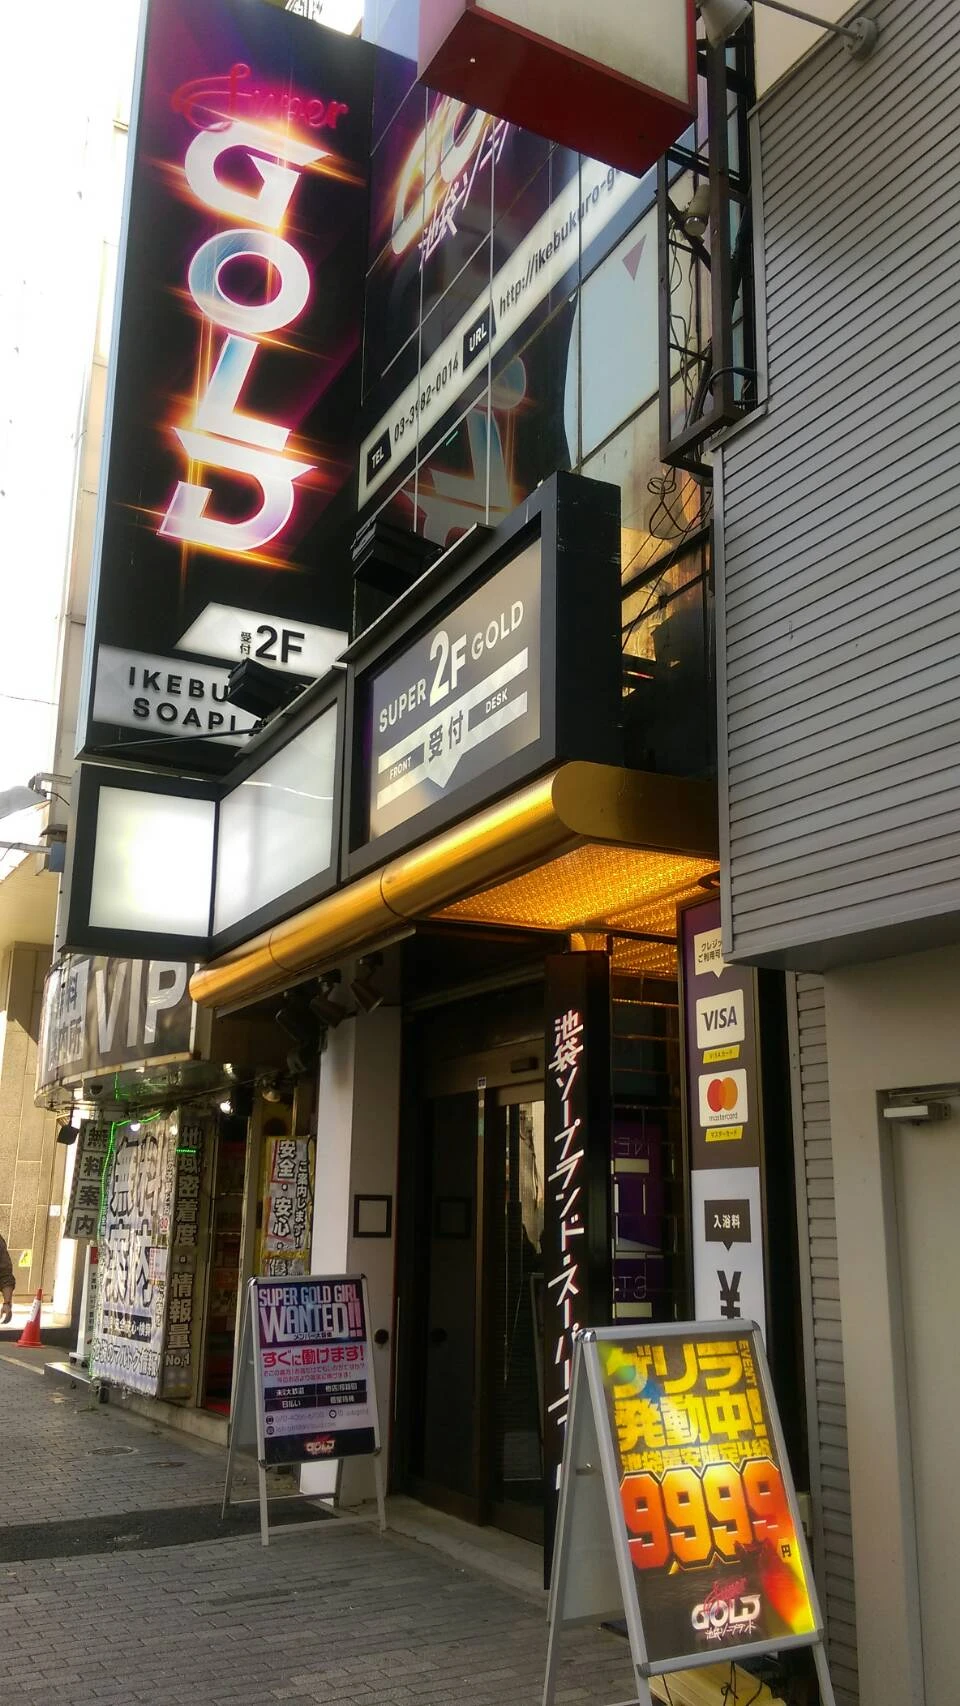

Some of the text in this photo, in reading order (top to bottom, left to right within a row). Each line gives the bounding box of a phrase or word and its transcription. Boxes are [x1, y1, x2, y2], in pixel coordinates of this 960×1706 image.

[157, 121, 332, 551] GOLD
[371, 445, 385, 469] TEL
[469, 323, 487, 351] URL
[499, 167, 618, 317] http://ikebukuro-g
[255, 625, 305, 663] 2F
[128, 666, 229, 703] IKEBU
[379, 600, 524, 733] SUPER 2F GOLD
[389, 688, 508, 780] FRONT 受付 DESK
[95, 958, 188, 1054] VIP
[701, 1006, 738, 1031] VISA
[708, 1112, 738, 1122] mastercard
[713, 1214, 741, 1229] 入浴料
[259, 1284, 360, 1307] SUPER GOLD GIRL
[260, 1302, 363, 1343] WANTED!!
[263, 1345, 365, 1368] すぐに働けます!
[607, 1340, 743, 1399] ゲリラ
[738, 1340, 757, 1386] EVENT
[614, 1388, 768, 1452] 発動中!
[619, 1457, 794, 1569] 9999 円
[691, 1594, 760, 1629] GOLD
